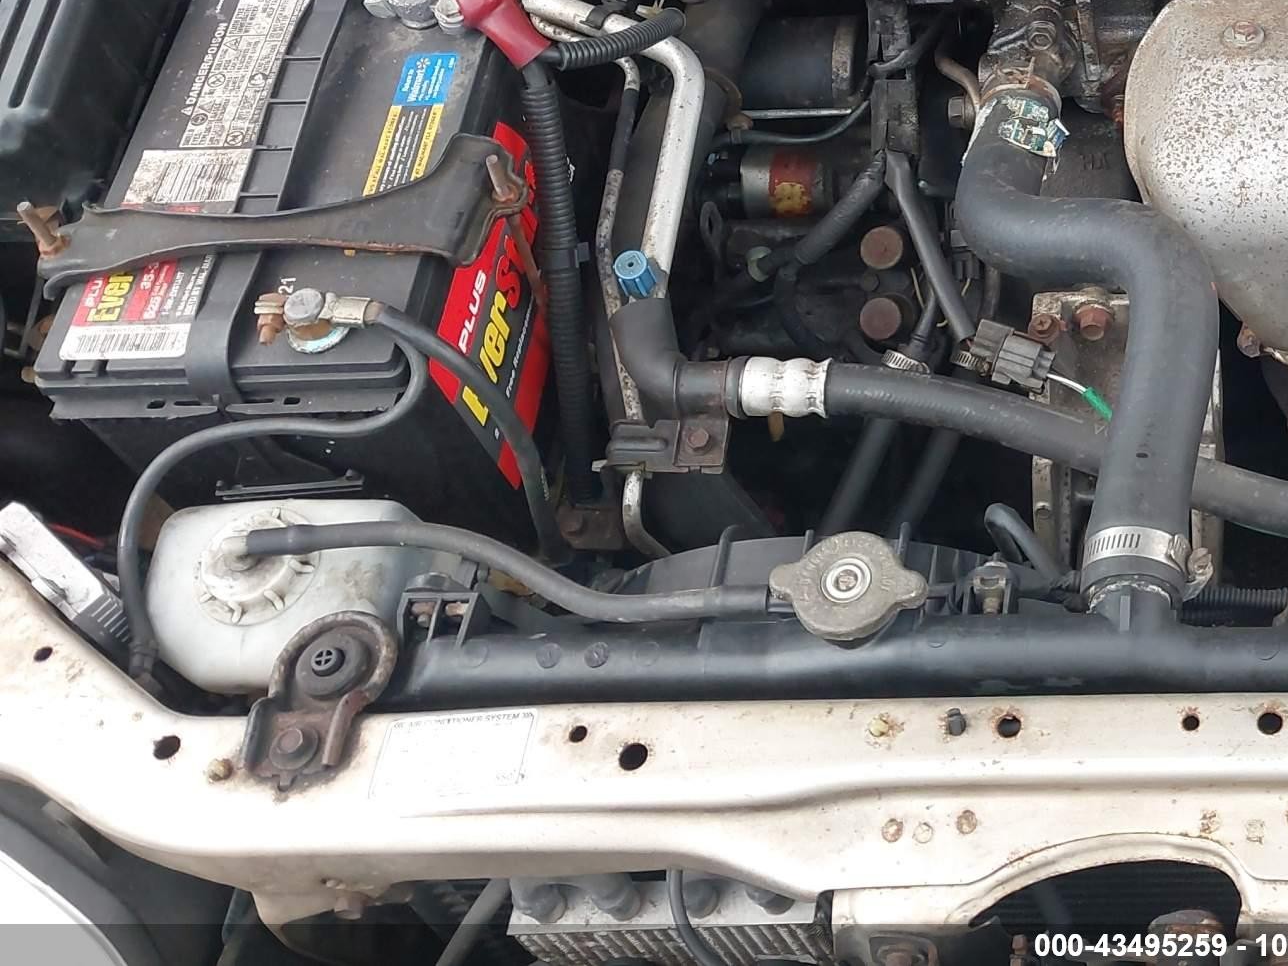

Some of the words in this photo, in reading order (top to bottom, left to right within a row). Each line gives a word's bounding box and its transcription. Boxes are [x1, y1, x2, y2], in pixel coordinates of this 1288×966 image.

[406, 70, 426, 103] Walmart
[457, 268, 487, 354] PLUS
[485, 712, 520, 723] SYSTEM
